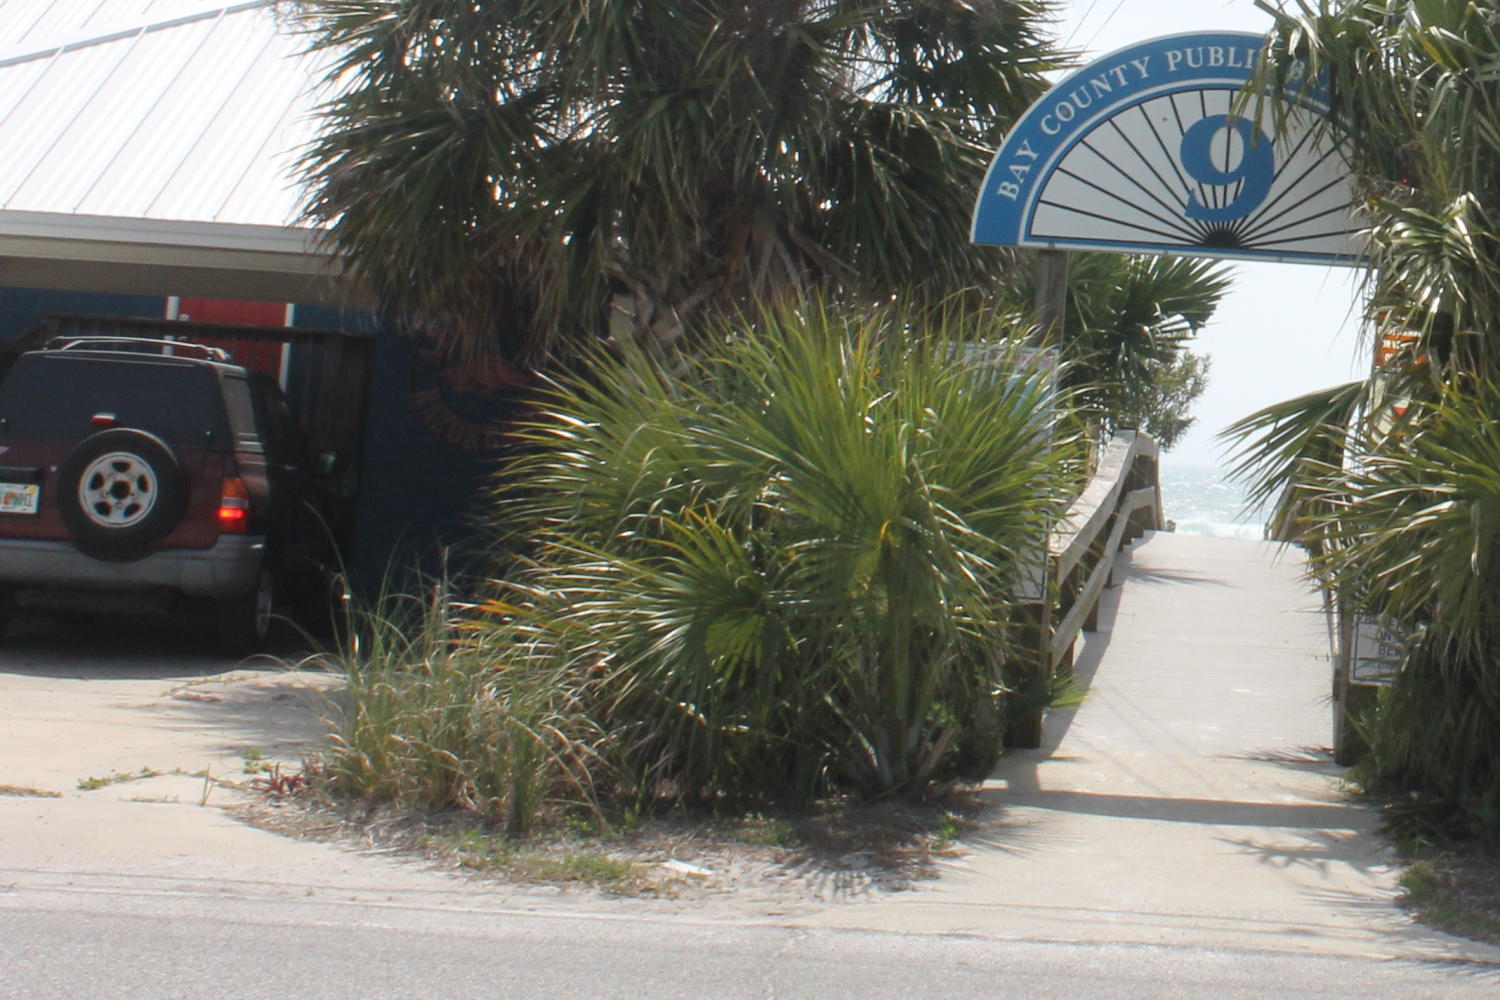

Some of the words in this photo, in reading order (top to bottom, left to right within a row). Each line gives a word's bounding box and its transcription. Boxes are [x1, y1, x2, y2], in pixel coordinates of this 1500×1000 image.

[997, 138, 1040, 202] BAY
[1040, 56, 1151, 136] COUNTY
[1165, 45, 1265, 72] PUBLI
[1179, 113, 1275, 222] 9
